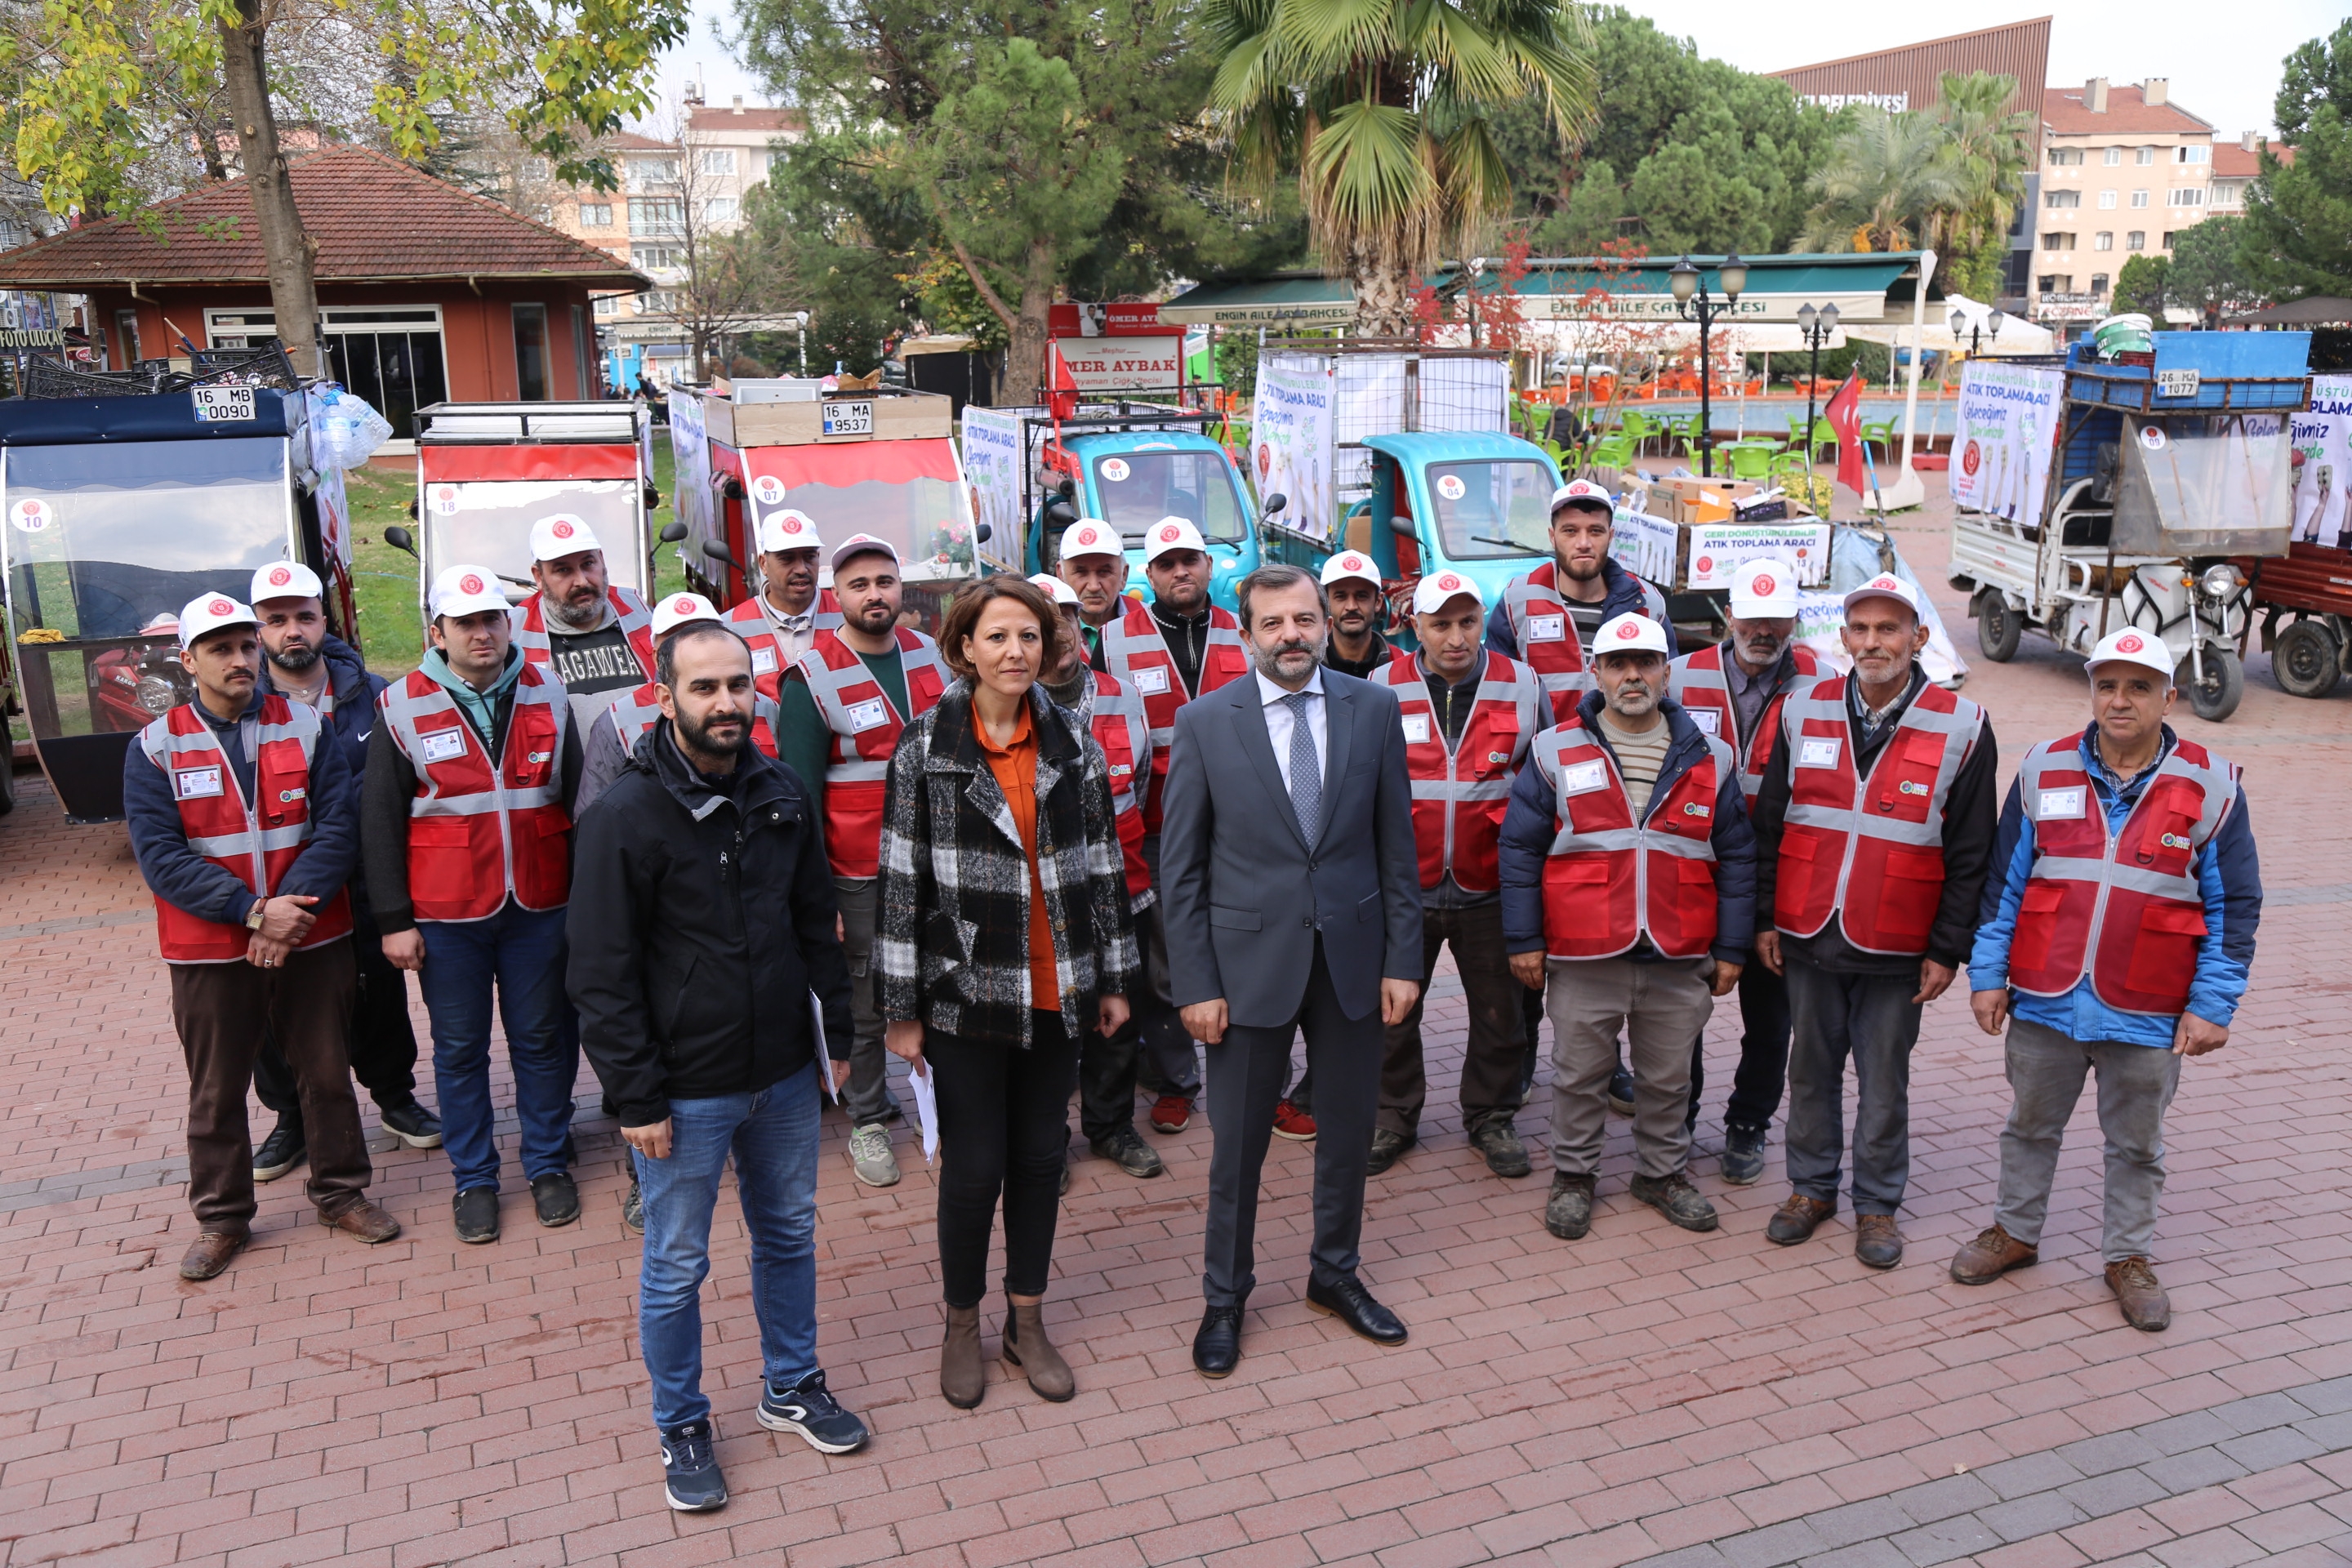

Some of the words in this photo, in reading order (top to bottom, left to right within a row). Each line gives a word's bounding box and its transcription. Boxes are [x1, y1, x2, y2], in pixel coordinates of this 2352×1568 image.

[1065, 361, 1107, 372] MER
[1112, 360, 1176, 372] AYBAK
[1073, 376, 1108, 385] dıyaman
[2162, 373, 2173, 381] 26
[2168, 384, 2193, 394] 1077
[197, 390, 213, 403] 16
[229, 390, 251, 403] MB
[209, 404, 249, 419] 0090
[826, 406, 840, 417] 16
[853, 405, 869, 416] MA
[835, 418, 867, 431] 9537
[764, 491, 777, 501] 07
[1447, 488, 1459, 497] 04
[441, 501, 455, 512] 18
[24, 516, 42, 528] 10
[1704, 530, 1726, 538] GERİ
[1704, 540, 1727, 548] ATIK
[1732, 539, 1780, 548] TOPLAMA
[1784, 538, 1815, 546] ARACI
[1797, 559, 1806, 568] 13
[557, 644, 641, 684] AGAWEA
[115, 675, 136, 688] KARGO
